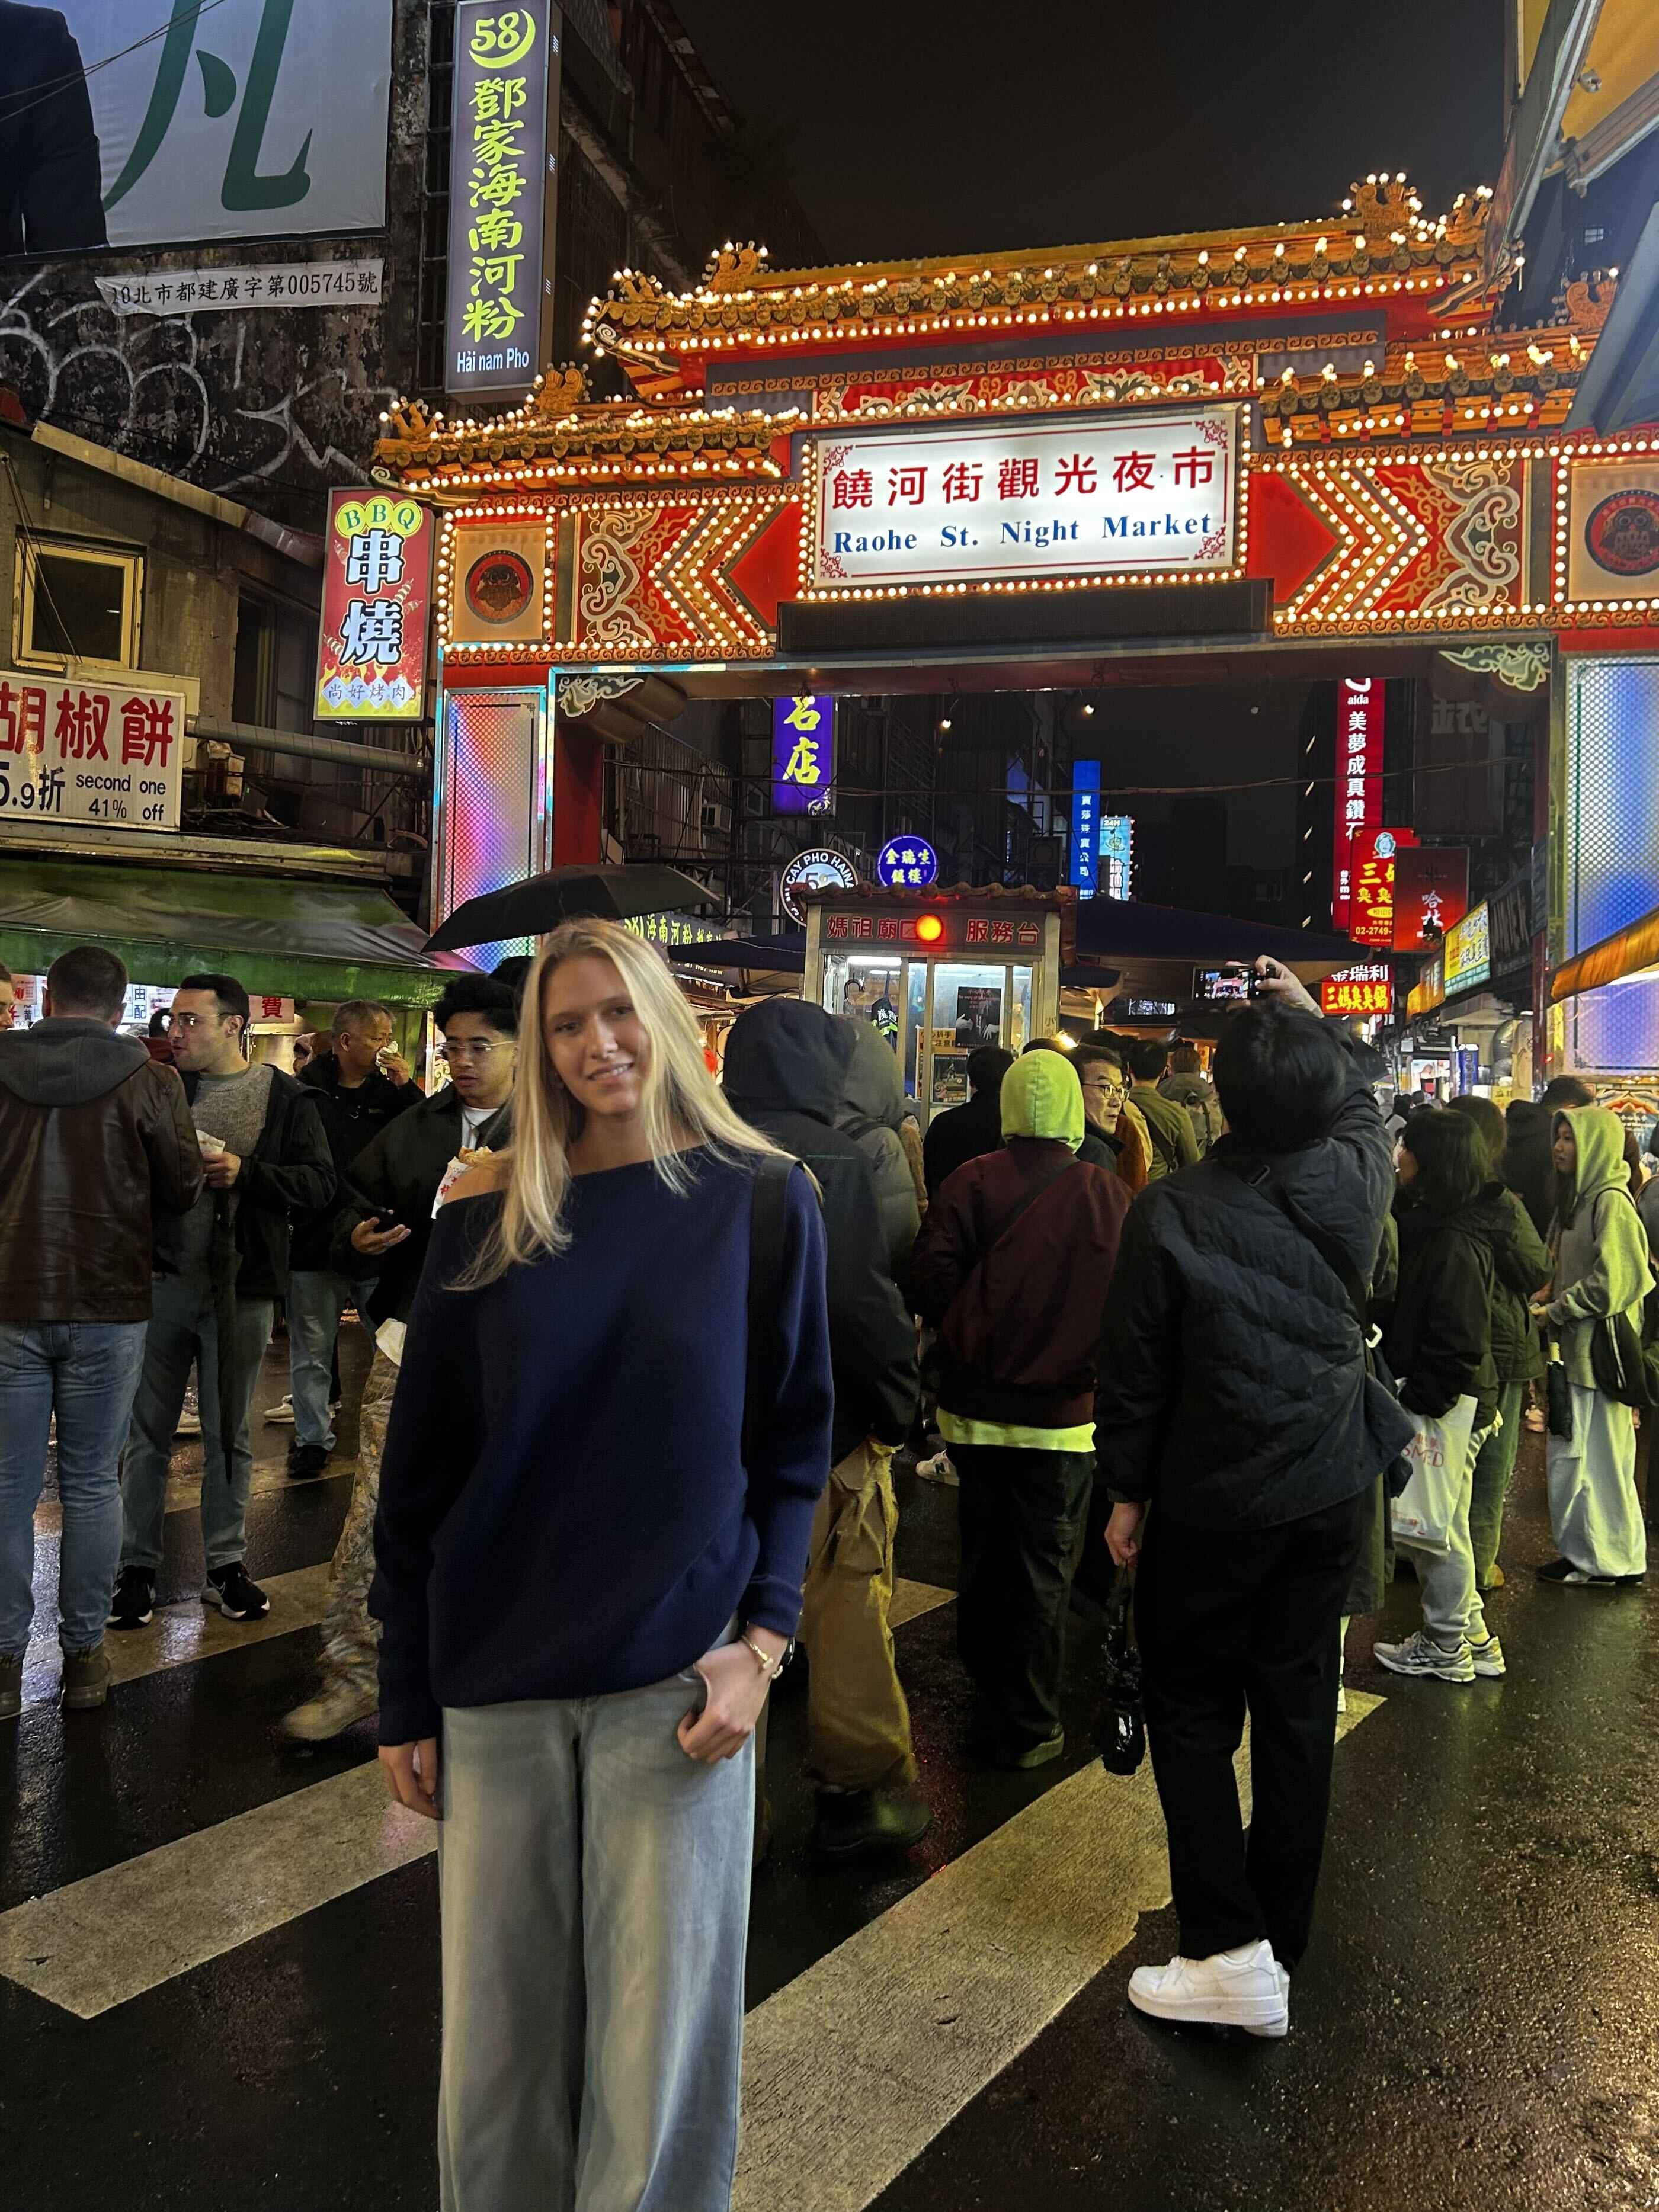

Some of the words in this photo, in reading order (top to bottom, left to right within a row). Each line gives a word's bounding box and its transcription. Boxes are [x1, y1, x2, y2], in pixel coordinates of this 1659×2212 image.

[470, 12, 520, 52] 58
[463, 76, 527, 342] 鄧家海南河粉
[479, 353, 503, 371] nam
[506, 347, 529, 368] Pho
[832, 445, 1216, 511] 饒河街觀光夜市
[344, 501, 416, 530] BBQ
[834, 528, 918, 554] Raohe
[940, 525, 979, 549] St.
[1000, 519, 1080, 548] Night
[1102, 512, 1212, 540] Market
[340, 527, 405, 666] 串燒
[328, 684, 406, 701] 尚好烤肉
[0, 681, 174, 768] 胡椒餅
[76, 774, 131, 793] second
[139, 780, 166, 795] one
[89, 798, 127, 819] 41%
[143, 803, 164, 821] off
[786, 860, 804, 885] CAY
[803, 852, 830, 865] PHO
[966, 919, 1040, 946] 服務台
[261, 996, 283, 1018] 費
[1325, 985, 1388, 1011] 三媽臭臭鍋
